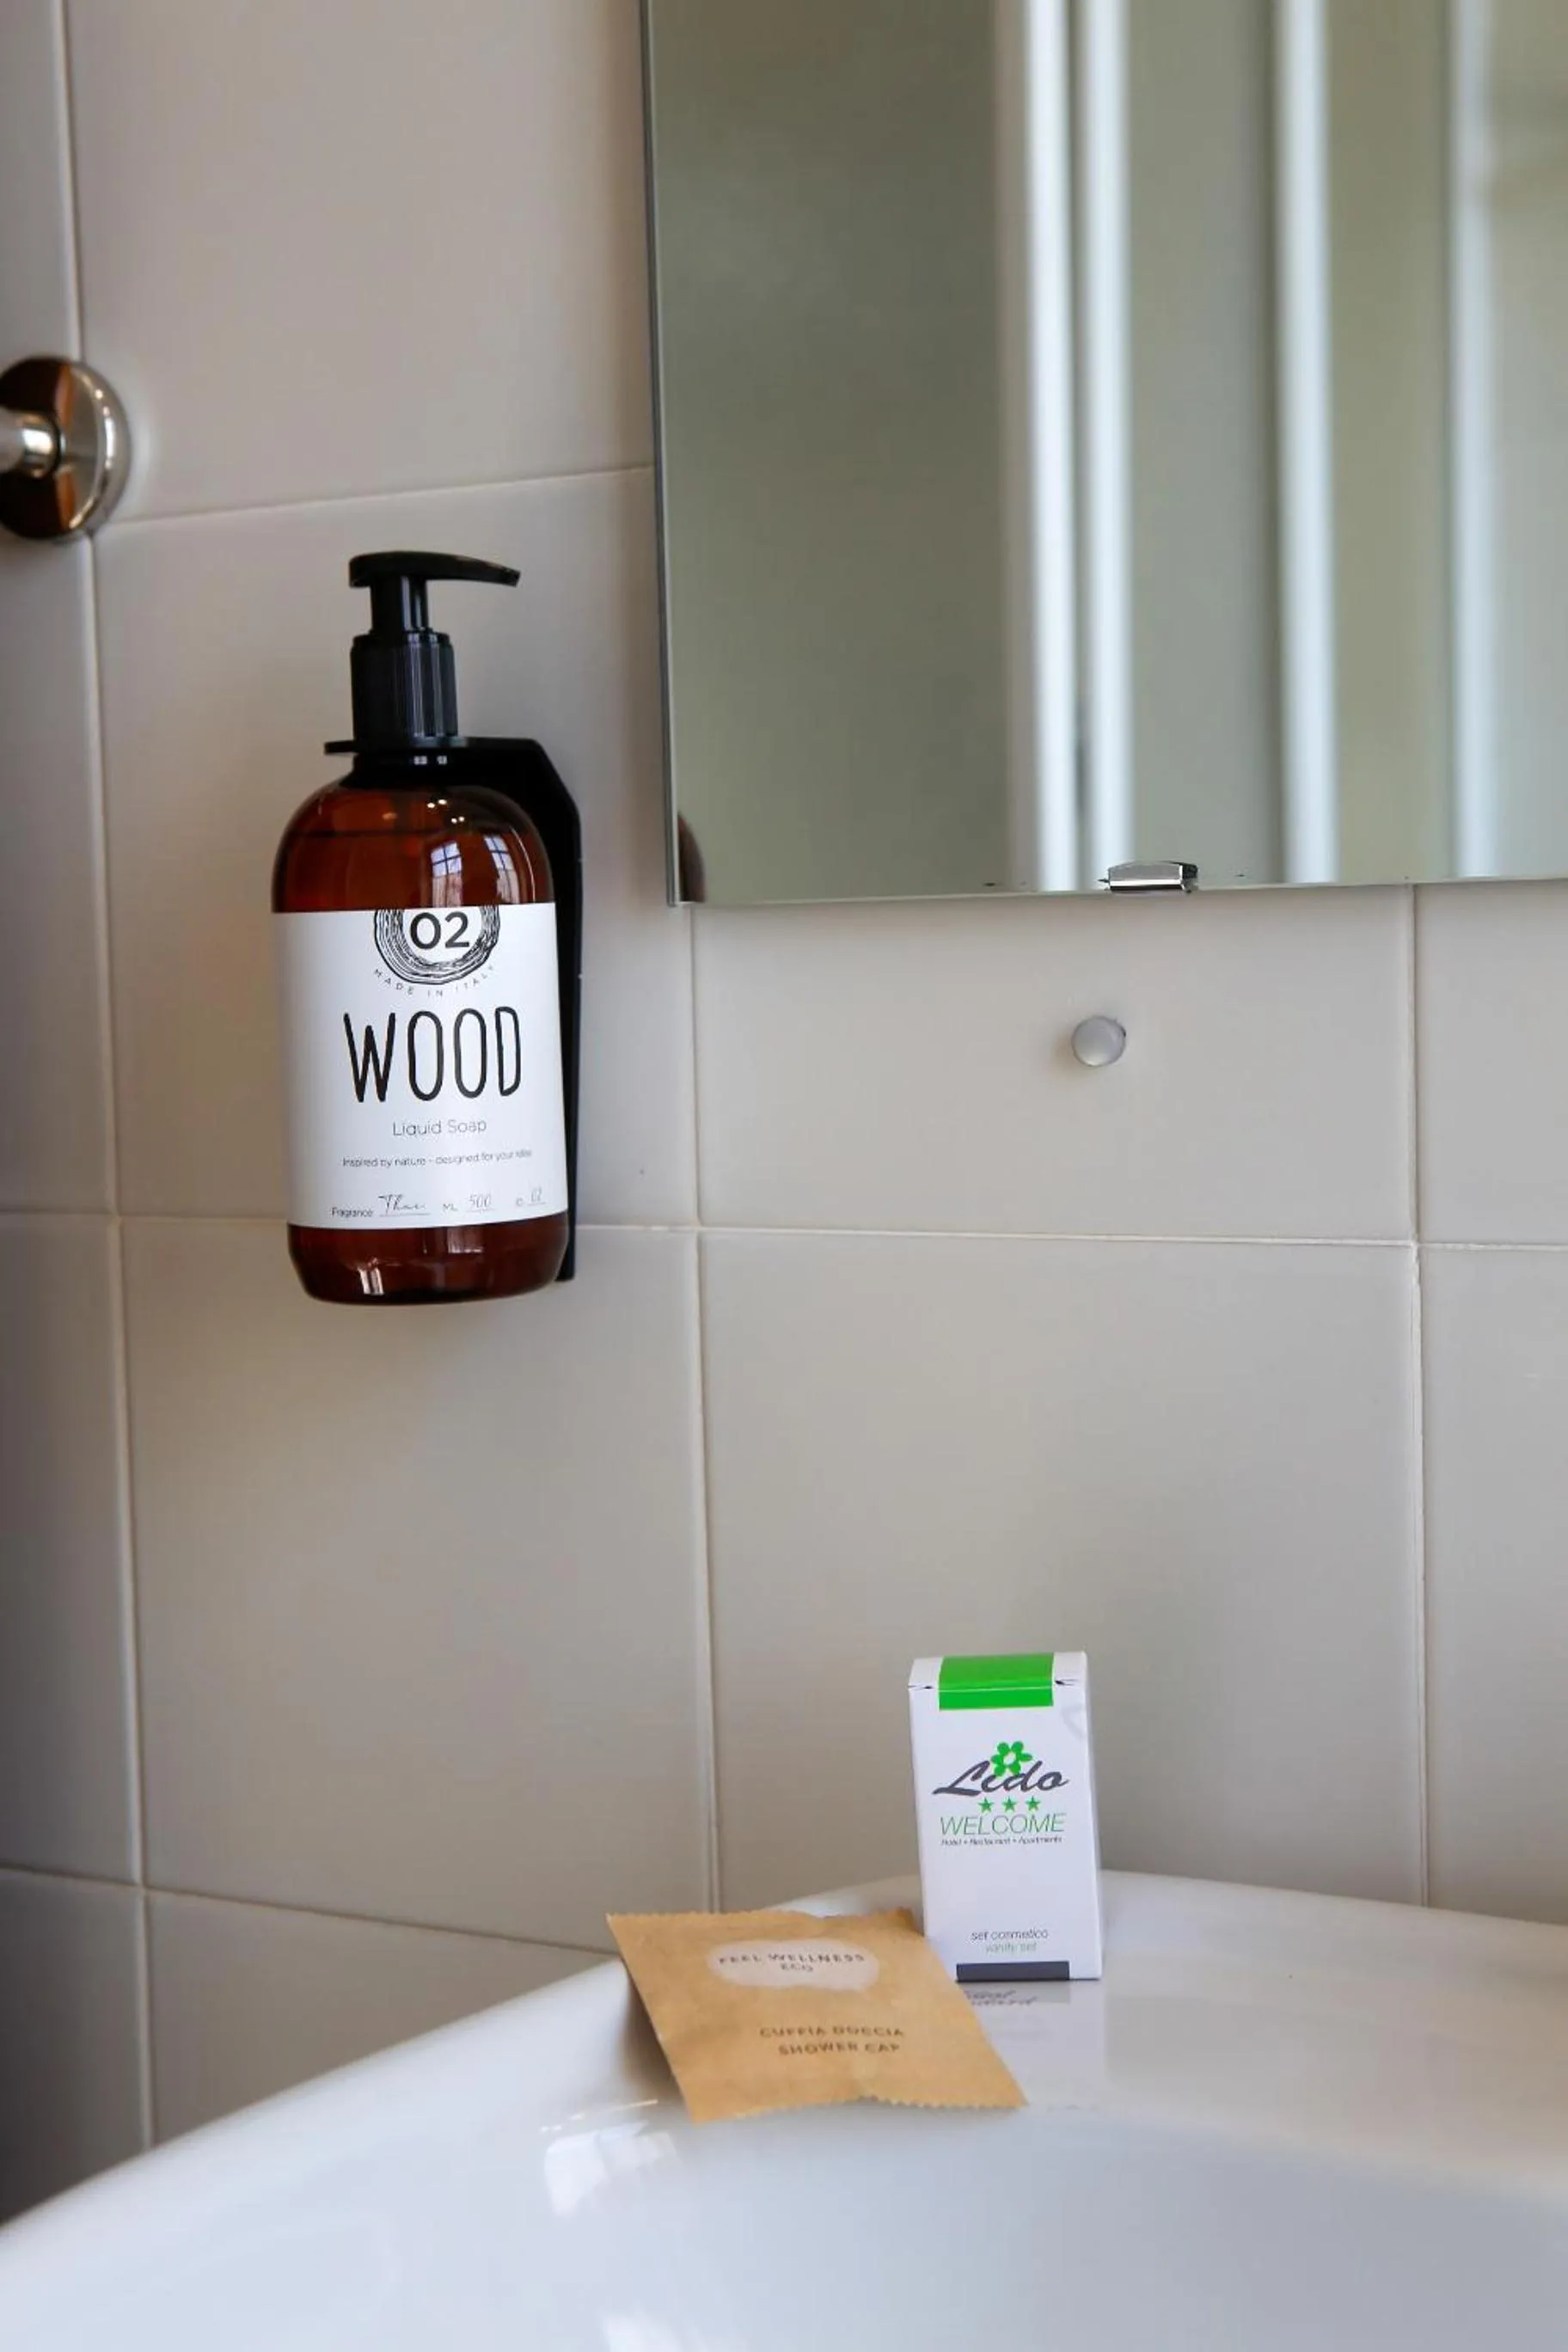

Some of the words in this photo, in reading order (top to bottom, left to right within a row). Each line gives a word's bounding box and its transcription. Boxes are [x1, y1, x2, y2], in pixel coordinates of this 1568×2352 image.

[411, 911, 470, 949] 02
[373, 968, 415, 995] MADE
[427, 989, 444, 998] IN
[456, 965, 496, 994] ITALY
[343, 1006, 521, 1103] WOOD
[392, 1120, 442, 1136] Liquid
[447, 1119, 487, 1136] Soap
[395, 1157, 426, 1167] nature
[331, 1206, 374, 1218] Fragrance
[932, 1761, 1069, 1797] Lido
[940, 1813, 1067, 1835] WELCOME
[1019, 1834, 1063, 1845] Apartments
[719, 1953, 763, 1964] FEEL
[768, 1953, 866, 1963] WELLNESS
[760, 2026, 827, 2038] CUFFIA
[777, 2042, 859, 2055] SHOWER
[865, 2043, 900, 2054] CAP
